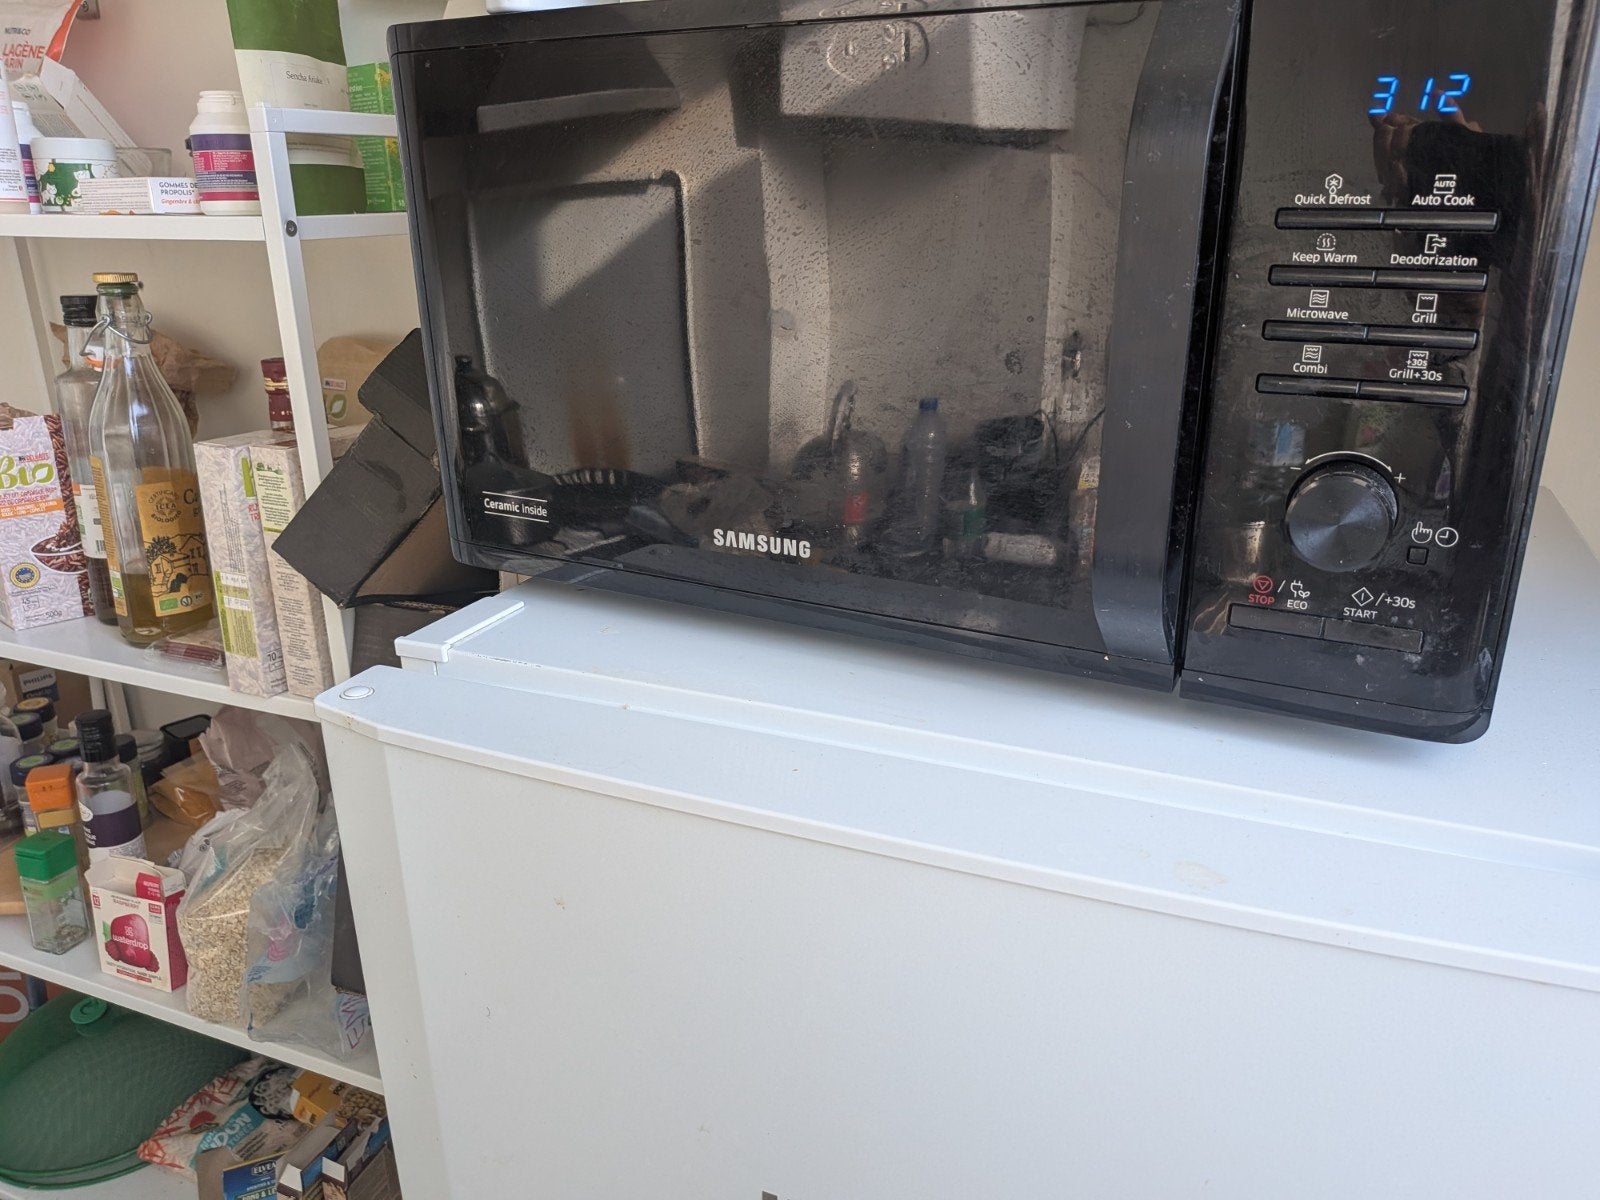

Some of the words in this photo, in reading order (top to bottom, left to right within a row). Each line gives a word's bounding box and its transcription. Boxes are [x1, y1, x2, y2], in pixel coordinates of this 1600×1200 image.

[285, 70, 307, 82] Sencha
[159, 181, 189, 189] GOMMES
[1434, 180, 1456, 188] AUTO
[1294, 193, 1326, 206] Quick
[1329, 193, 1371, 205] Defrost
[1411, 194, 1441, 206] Auto
[1443, 194, 1475, 206] Cook
[1292, 251, 1321, 265] Keep
[1323, 252, 1358, 264] Warm
[1390, 253, 1478, 267] Deodorization
[1286, 307, 1349, 320] Microwave
[1411, 312, 1438, 324] Grill
[1293, 362, 1328, 374] Combi
[1389, 368, 1443, 381] Grill+30s
[484, 498, 520, 512] Ceramic
[521, 503, 548, 517] Inside
[713, 528, 811, 559] SAMSUNG
[1248, 593, 1275, 605] STOP
[1286, 599, 1308, 610] ECO
[1343, 607, 1378, 620] START
[112, 934, 149, 951] waterdrop
